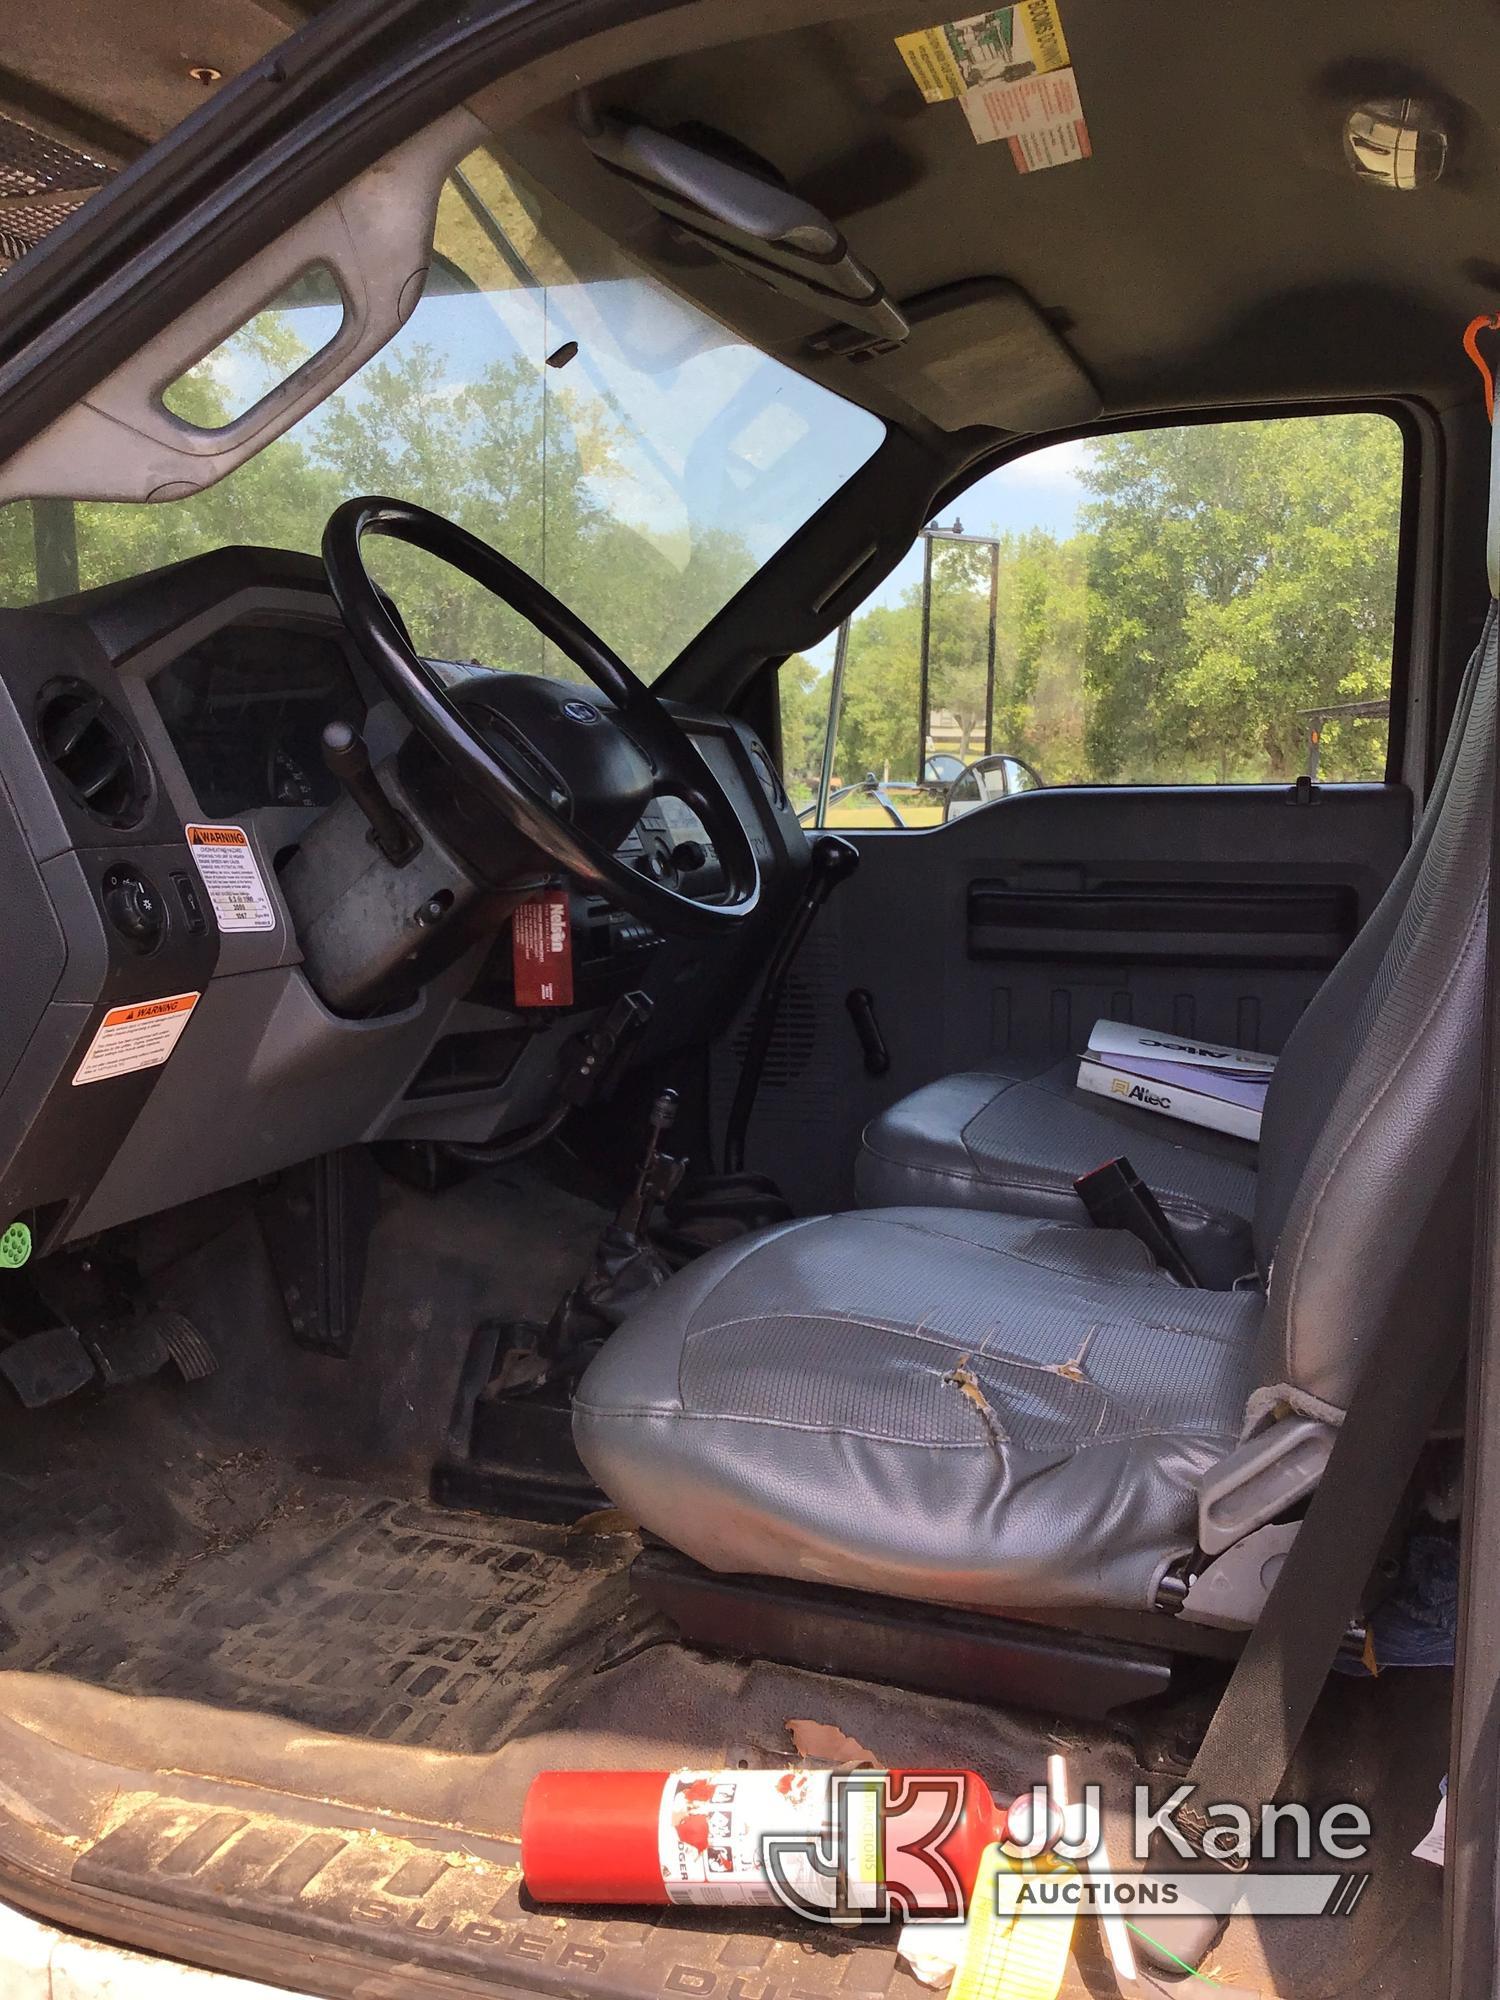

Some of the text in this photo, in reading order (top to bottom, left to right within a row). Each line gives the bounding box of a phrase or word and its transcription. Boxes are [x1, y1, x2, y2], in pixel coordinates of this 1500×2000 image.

[201, 832, 245, 844] WARNING
[549, 904, 566, 953] Nelson
[137, 1002, 178, 1018] WARNING
[1128, 1085, 1171, 1110] Altec
[350, 1902, 607, 1974] SUPER
